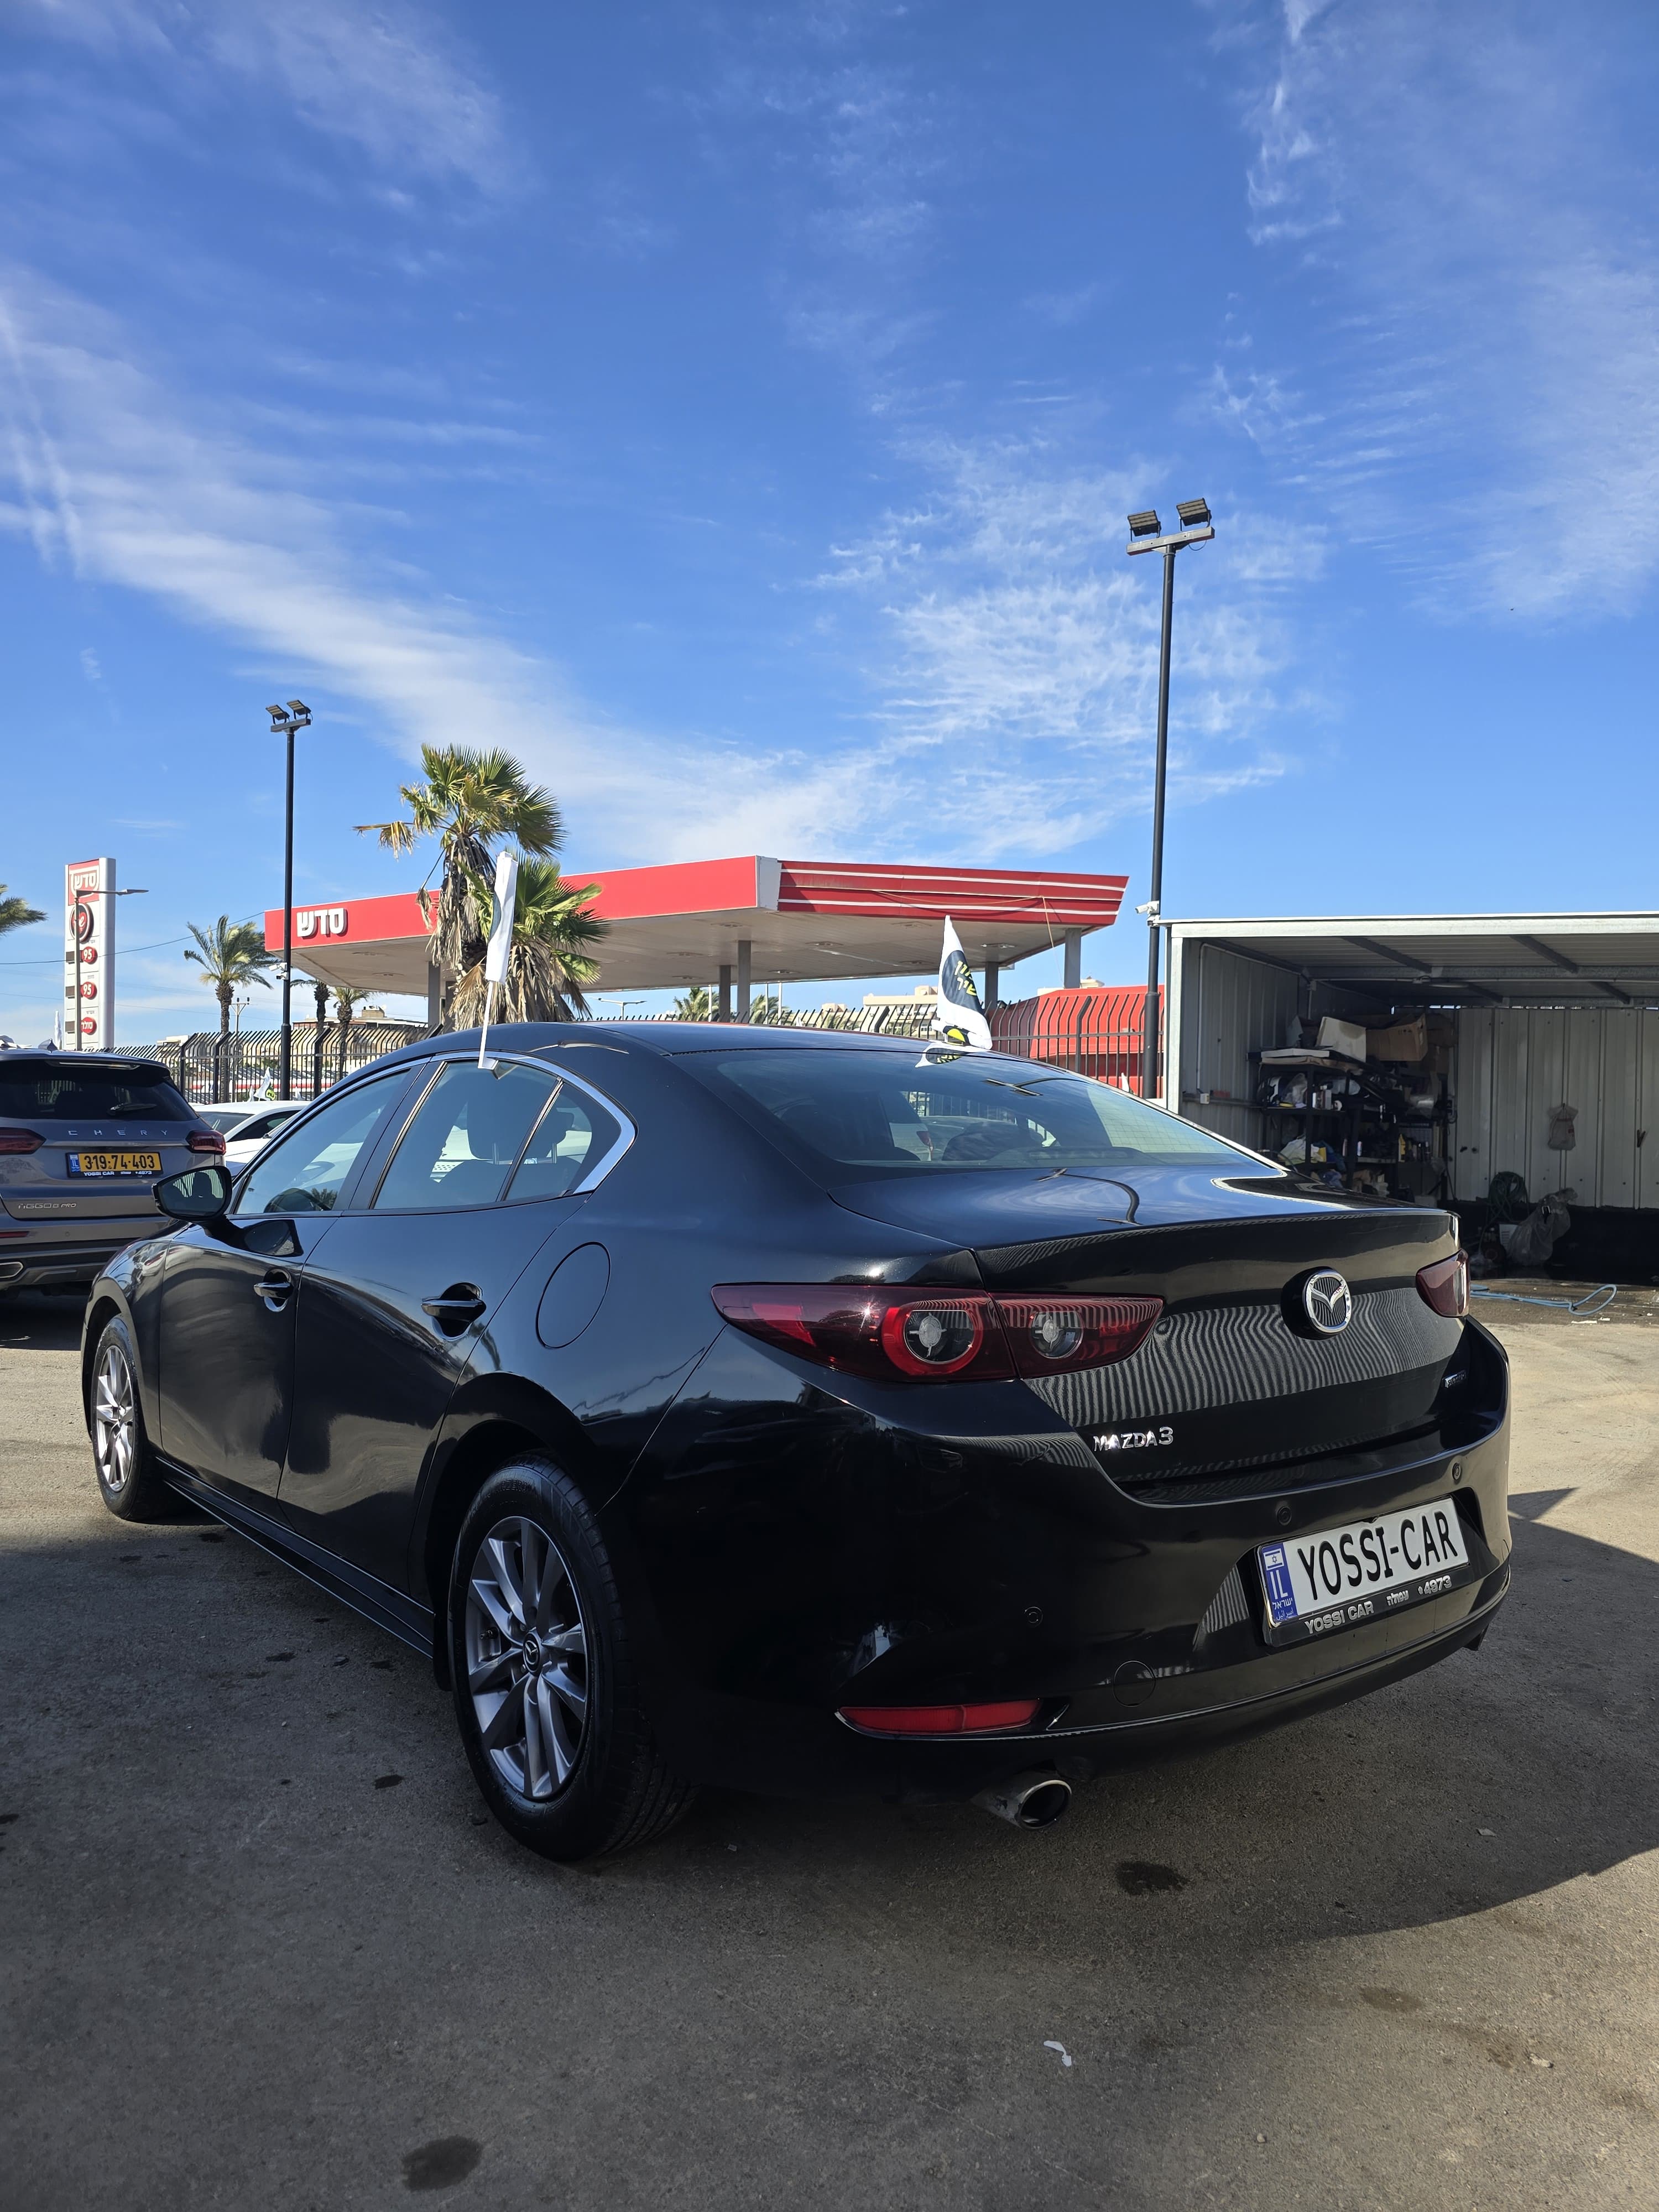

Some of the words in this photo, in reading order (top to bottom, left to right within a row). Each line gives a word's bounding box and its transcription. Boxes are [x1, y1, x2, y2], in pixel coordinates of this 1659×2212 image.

[296, 907, 346, 938] סדש
[84, 949, 92, 960] 95
[83, 984, 92, 995] 95
[81, 1021, 93, 1030] סולר
[1297, 1510, 1458, 1600] YOSSI-CAR
[1270, 1570, 1288, 1600] IL
[1272, 1597, 1293, 1610] ישראל
[1305, 1609, 1345, 1635] YOSSI
[1348, 1600, 1375, 1621] CAR
